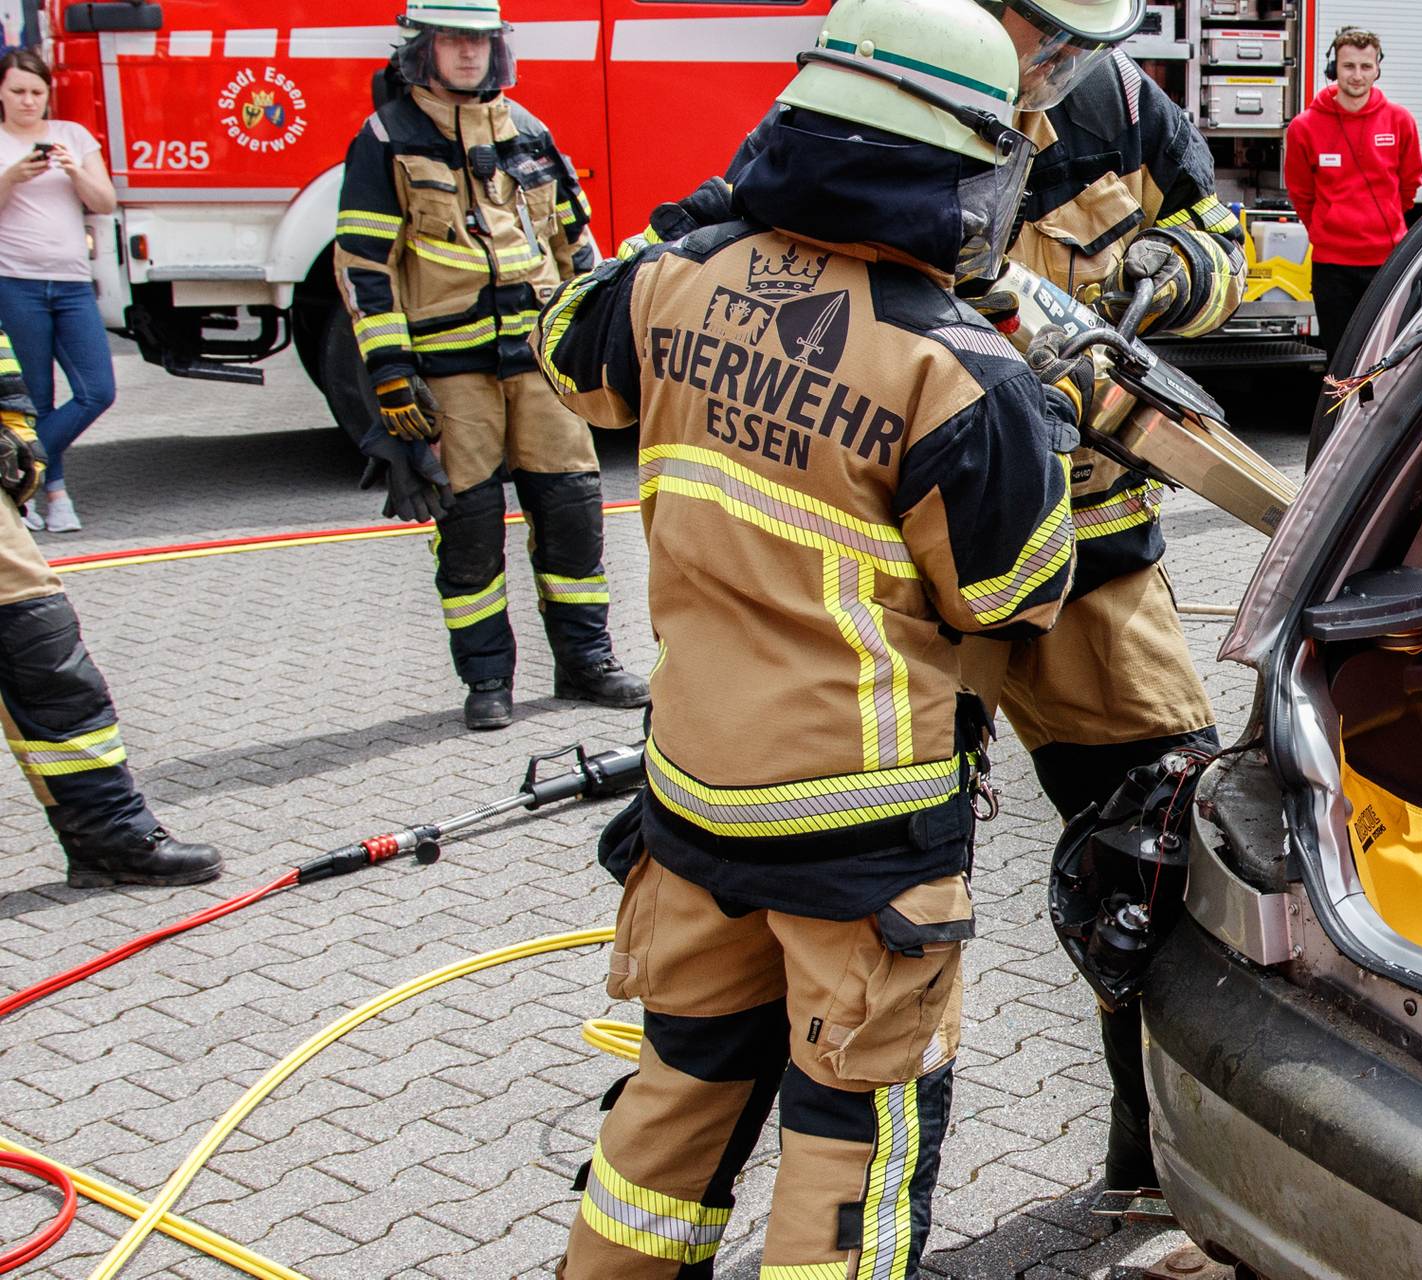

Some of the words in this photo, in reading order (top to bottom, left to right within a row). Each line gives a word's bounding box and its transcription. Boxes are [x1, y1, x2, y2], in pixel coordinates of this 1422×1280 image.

[218, 67, 256, 110] Stadt
[264, 66, 306, 110] Essen
[132, 140, 210, 170] 2/35
[221, 116, 308, 153] Feuerwehr
[643, 326, 905, 467] FEUERWEHR
[706, 397, 811, 471] ESSEN
